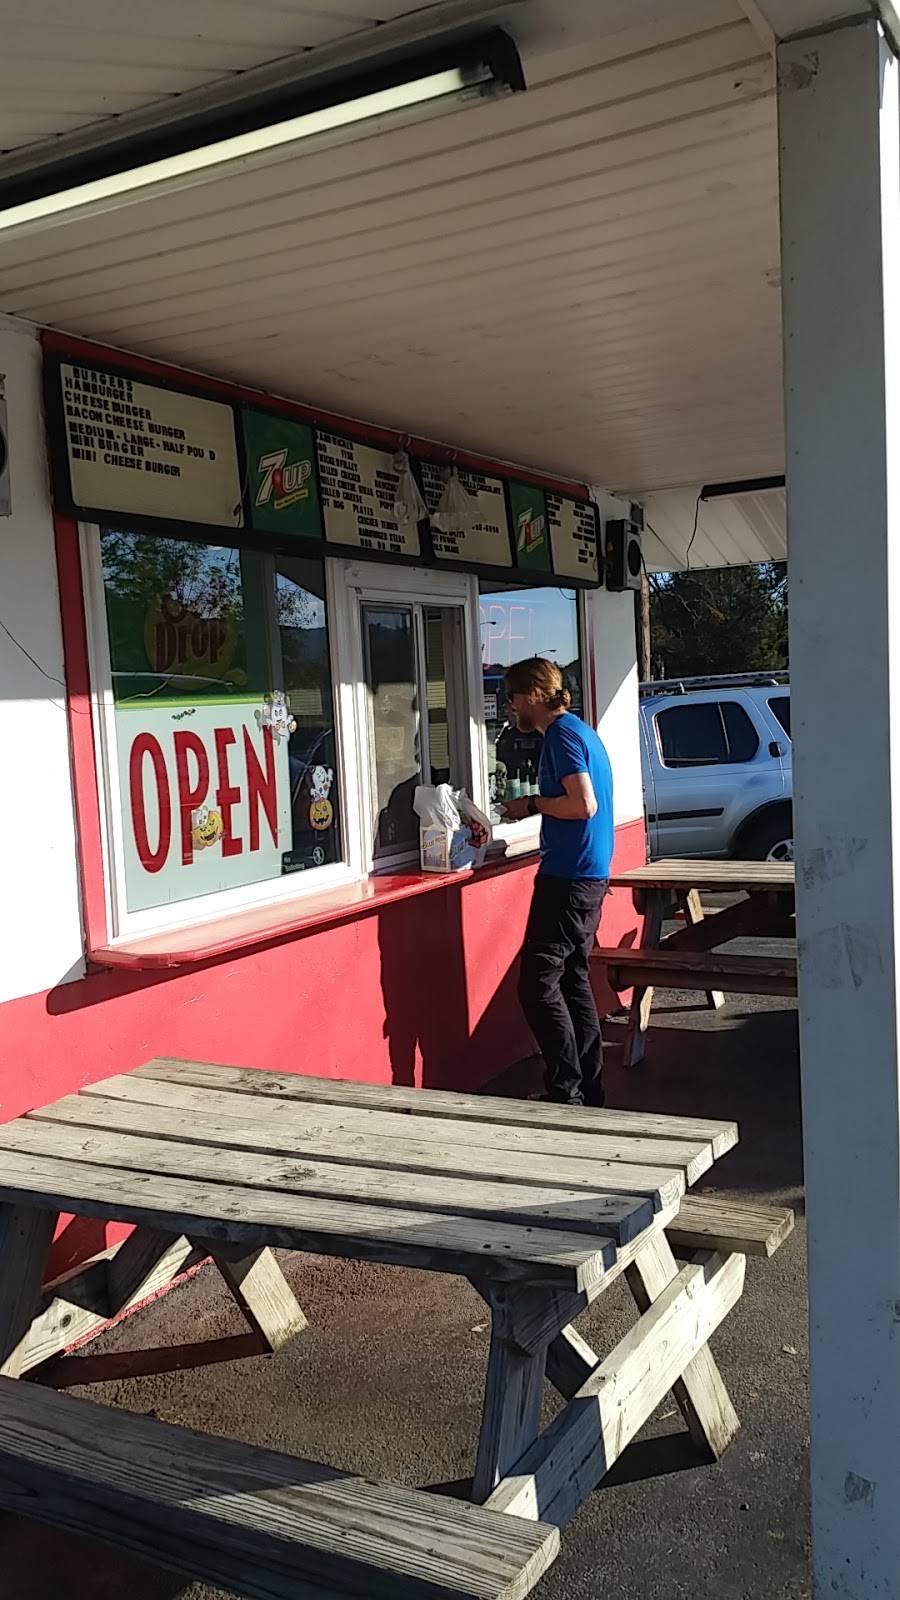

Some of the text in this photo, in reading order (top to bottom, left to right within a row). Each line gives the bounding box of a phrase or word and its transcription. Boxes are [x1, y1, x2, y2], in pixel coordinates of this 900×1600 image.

[65, 377, 133, 403] HAMBURGER
[73, 368, 133, 392] BURGERS
[64, 391, 152, 420] CHEESE BURGER
[66, 405, 186, 440] BACON CHEESE BURGER
[70, 433, 144, 457] MINI BURGER
[163, 441, 185, 454] HALF
[72, 447, 181, 477] MINI CHEESE BURGER
[129, 724, 279, 874] OPEN
